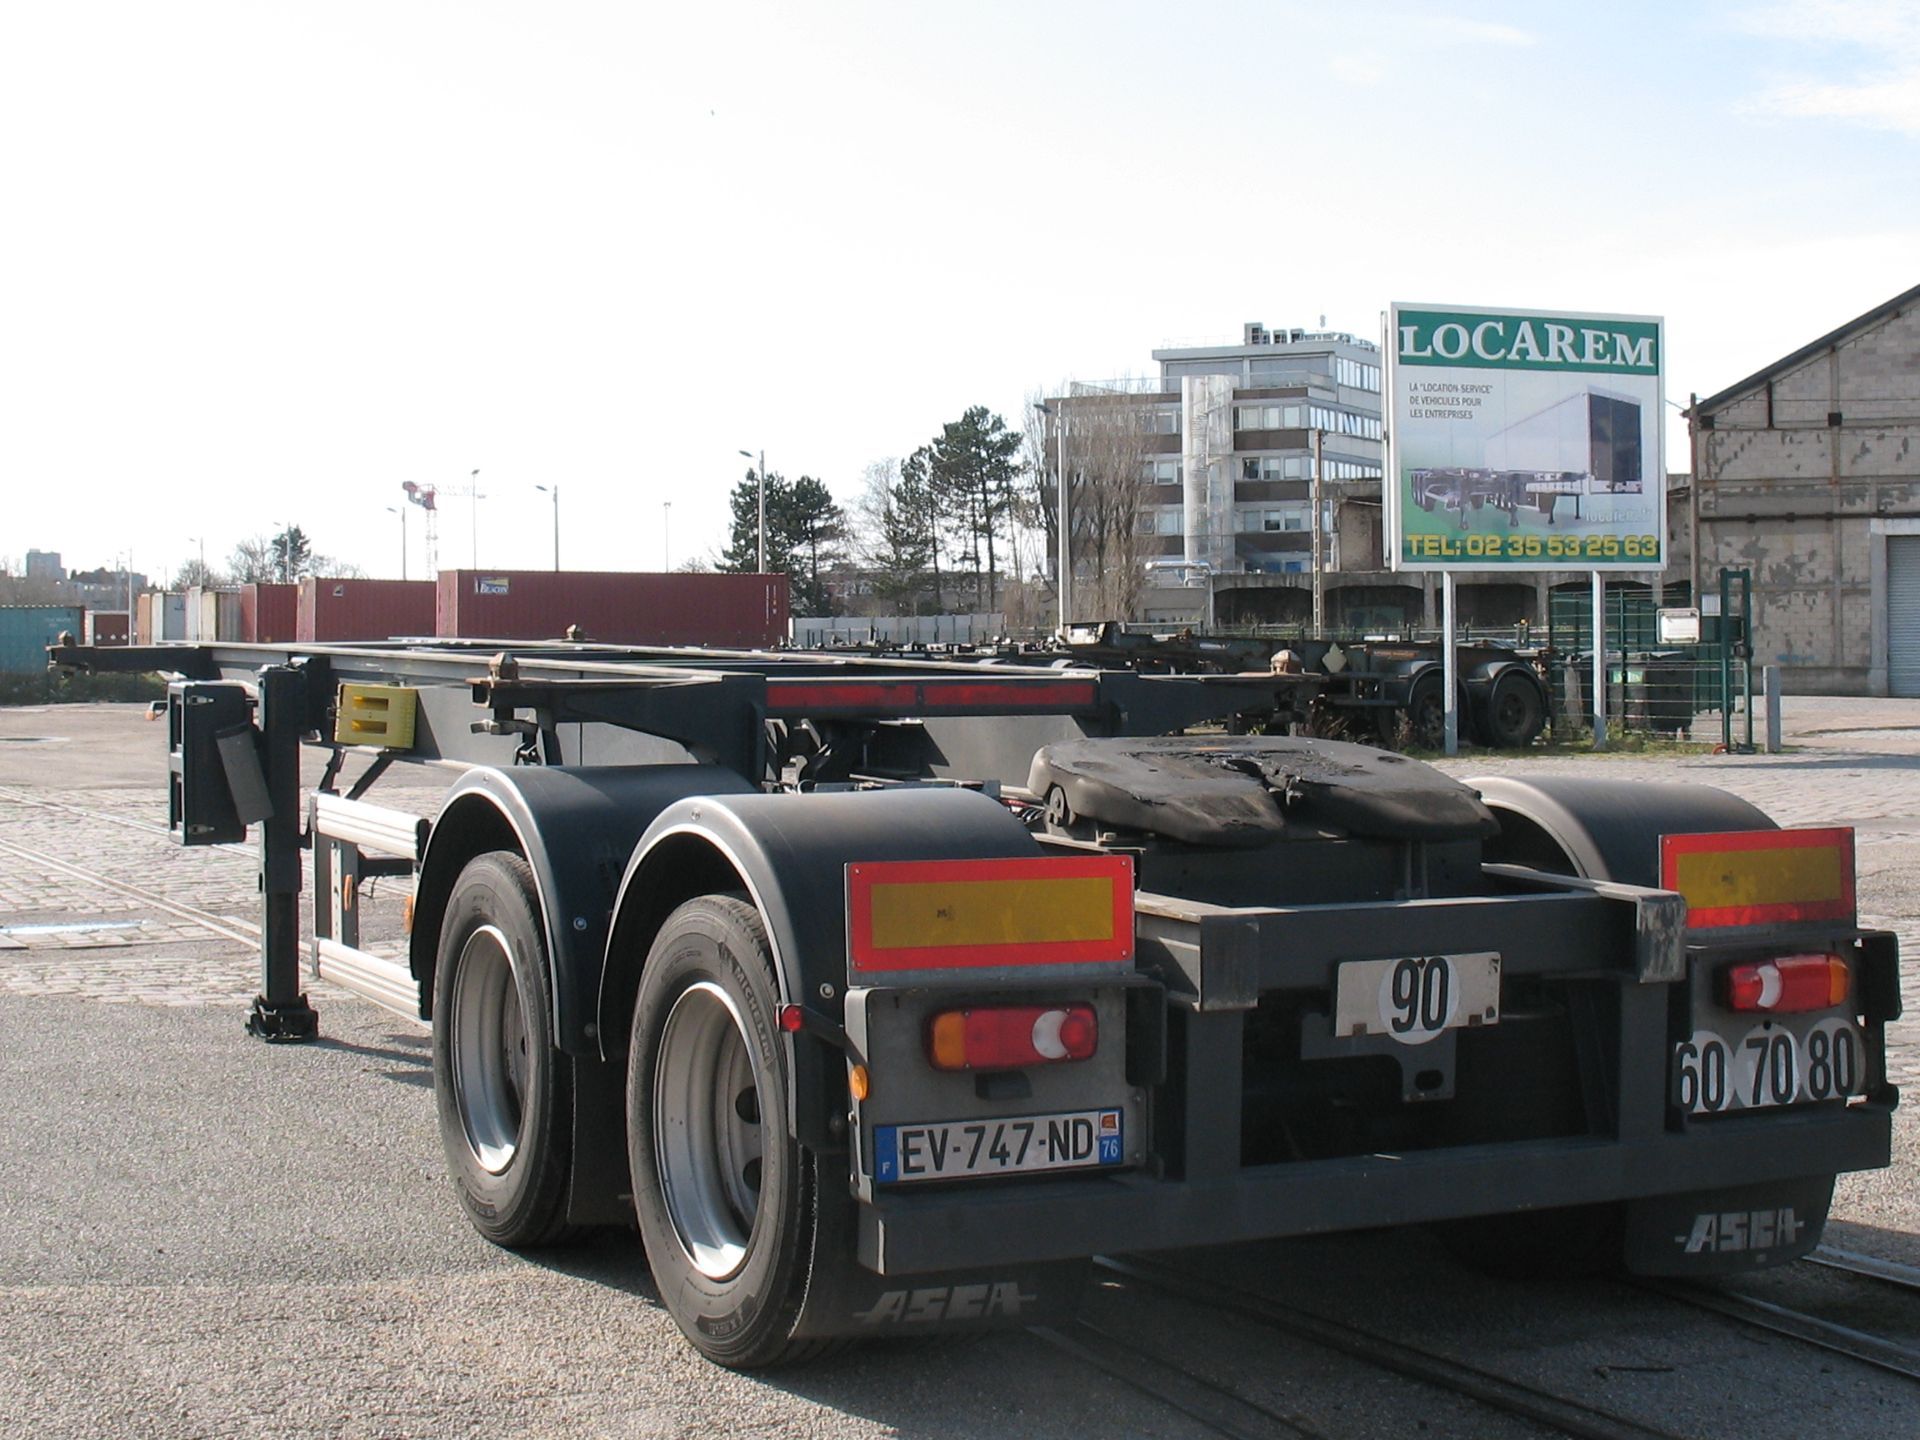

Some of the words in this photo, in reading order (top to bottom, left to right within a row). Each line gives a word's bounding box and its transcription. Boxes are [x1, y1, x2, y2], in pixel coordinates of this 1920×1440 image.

[1399, 321, 1654, 367] LOCAREM
[1409, 382, 1418, 392] LA
[1409, 396, 1419, 405] DE
[1462, 397, 1482, 407] POUR
[1410, 409, 1423, 418] LES
[1425, 409, 1473, 419] ENTREPRISES
[1466, 535, 1501, 556] 02
[1507, 535, 1541, 556] 35
[1547, 535, 1580, 557] 53
[1585, 534, 1619, 557] 25
[1624, 534, 1657, 557] 63
[733, 964, 772, 1062] MICHELIN
[1392, 956, 1449, 1033] 90
[1675, 1041, 1725, 1111] 60
[1746, 1034, 1794, 1105] 70
[1809, 1027, 1855, 1100] 80
[882, 1162, 890, 1174] F
[902, 1118, 1093, 1174] EV-747-ND
[1102, 1139, 1118, 1158] 76
